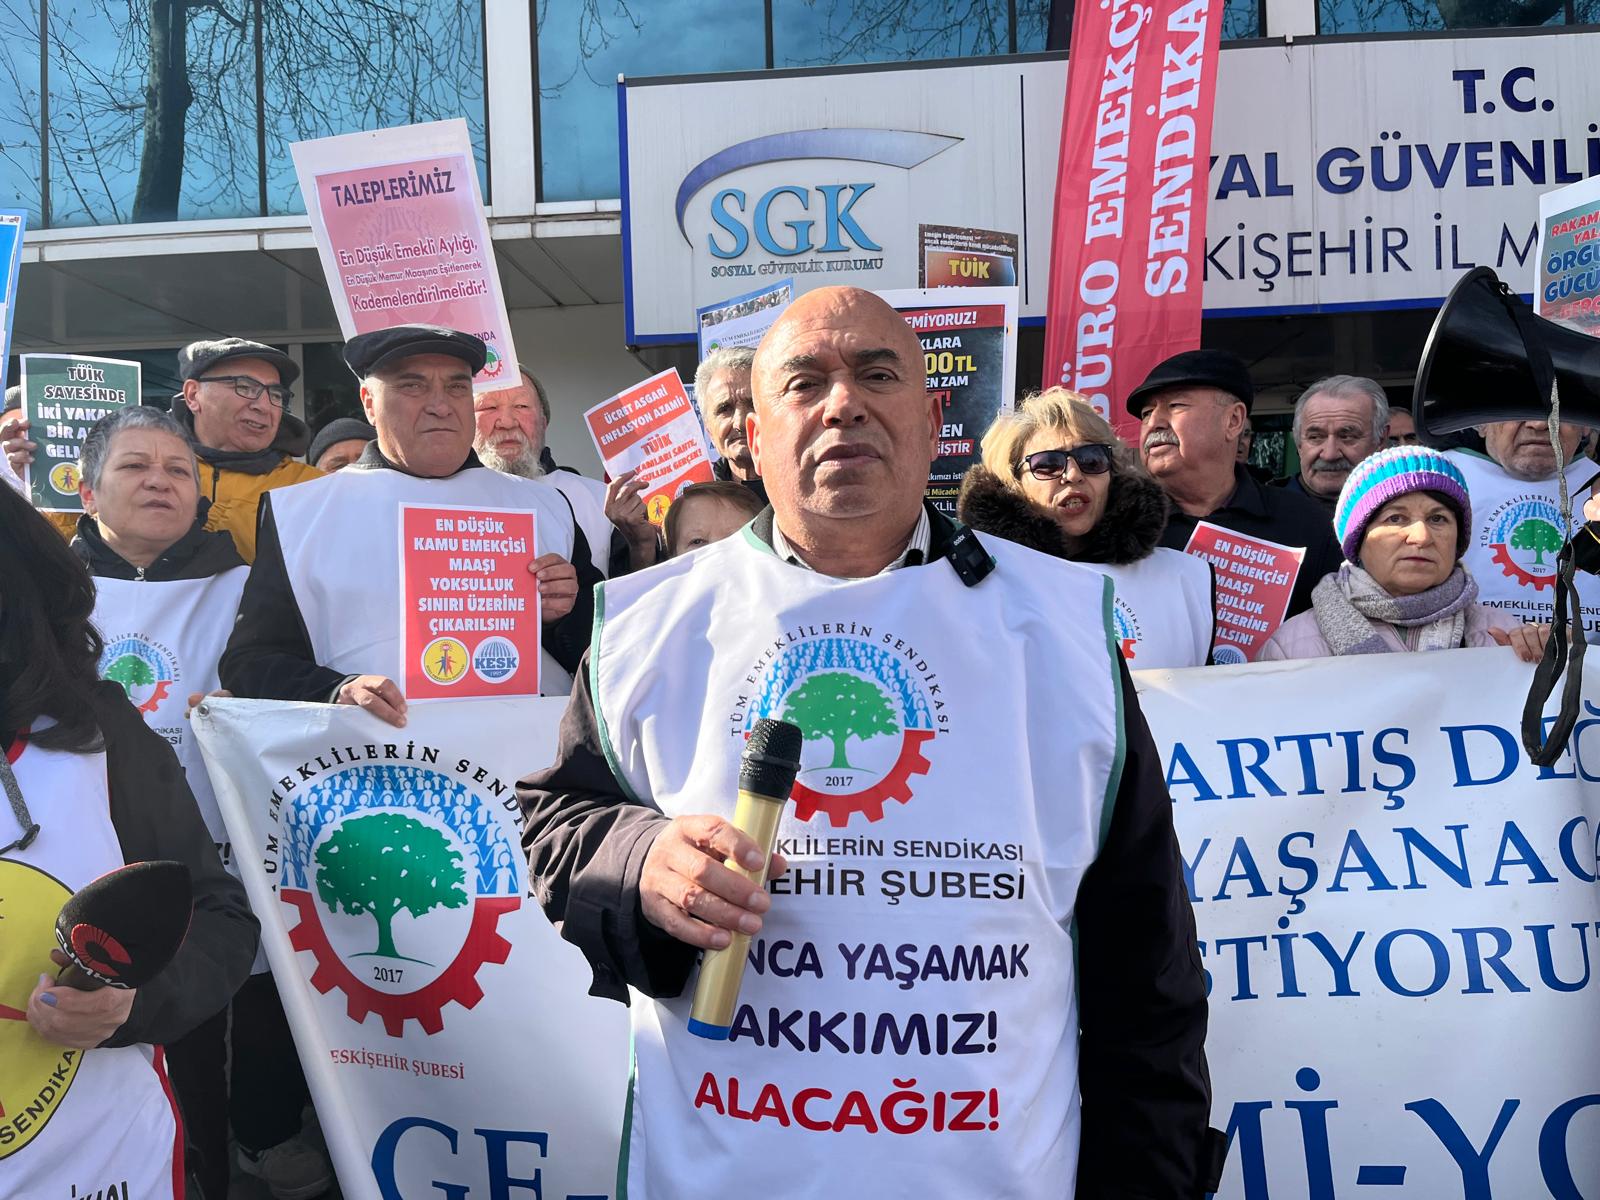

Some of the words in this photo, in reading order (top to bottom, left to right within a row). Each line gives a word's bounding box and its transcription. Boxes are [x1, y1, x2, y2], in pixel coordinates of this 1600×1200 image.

[1452, 66, 1555, 114] T.C.
[331, 166, 456, 207] TALEPLERİMİZ
[708, 183, 883, 260] SGK
[1434, 213, 1475, 271] İL
[1574, 227, 1600, 246] YAL
[339, 250, 353, 266] En
[356, 245, 392, 268] Düşük
[394, 239, 437, 261] Emekli
[439, 232, 478, 258] Aylığı,
[711, 265, 756, 278] SOSYAL
[758, 259, 825, 275] GÜVENLİK
[826, 258, 884, 272] KURUMU
[948, 256, 991, 279] TÜİK
[351, 280, 488, 311] Kademelendirilmelidir!
[67, 363, 105, 383] TÜİK
[941, 375, 969, 387] ZAM
[45, 384, 126, 404] SAYESİNDE
[603, 402, 634, 426] ÜCRET
[634, 384, 668, 410] ASGARİ
[37, 402, 62, 420] İKİ
[64, 406, 116, 422] YAKA
[46, 421, 73, 440] BİR
[600, 414, 654, 446] ENFLASYON
[641, 433, 673, 457] TÜİK
[435, 518, 454, 533] EN
[457, 516, 505, 536] DÜŞÜK
[413, 537, 458, 552] KAMU
[461, 536, 527, 557] EMEKÇİSİ
[1214, 538, 1232, 553] EN
[1232, 544, 1277, 567] DÜŞÜK
[449, 558, 496, 576] MAAŞI
[1229, 561, 1290, 586] EMEKÇİSİ
[429, 577, 514, 592] YOKSULLUK
[1215, 574, 1255, 596] MAAŞI
[418, 597, 464, 612] SINIRI
[466, 594, 525, 612] ÜZERİNE
[1215, 592, 1265, 615] SULLUK
[428, 617, 515, 636] ÇIKARILSIN!
[1216, 607, 1270, 632] ÜZERİNE
[474, 657, 518, 670] KESK
[730, 695, 748, 736] TÜM
[747, 621, 872, 684] EMEKLİLERİN
[882, 633, 950, 734] SENDİKASI
[825, 775, 853, 787] 2017
[1164, 727, 1417, 811] ARTIŞ
[268, 740, 441, 824] EMEKLİLERİN
[893, 838, 1024, 862] SENDİKASI
[1181, 815, 1600, 915] YAŞANAC
[880, 869, 1025, 906] ŞUBESİ
[373, 966, 404, 984] 2017
[838, 942, 1030, 990] YAŞAMAK
[329, 1047, 410, 1072] ESKİŞEHİR
[411, 1061, 466, 1080] ŞUBESİ
[694, 1071, 1000, 1135] ALACAĞIZ!
